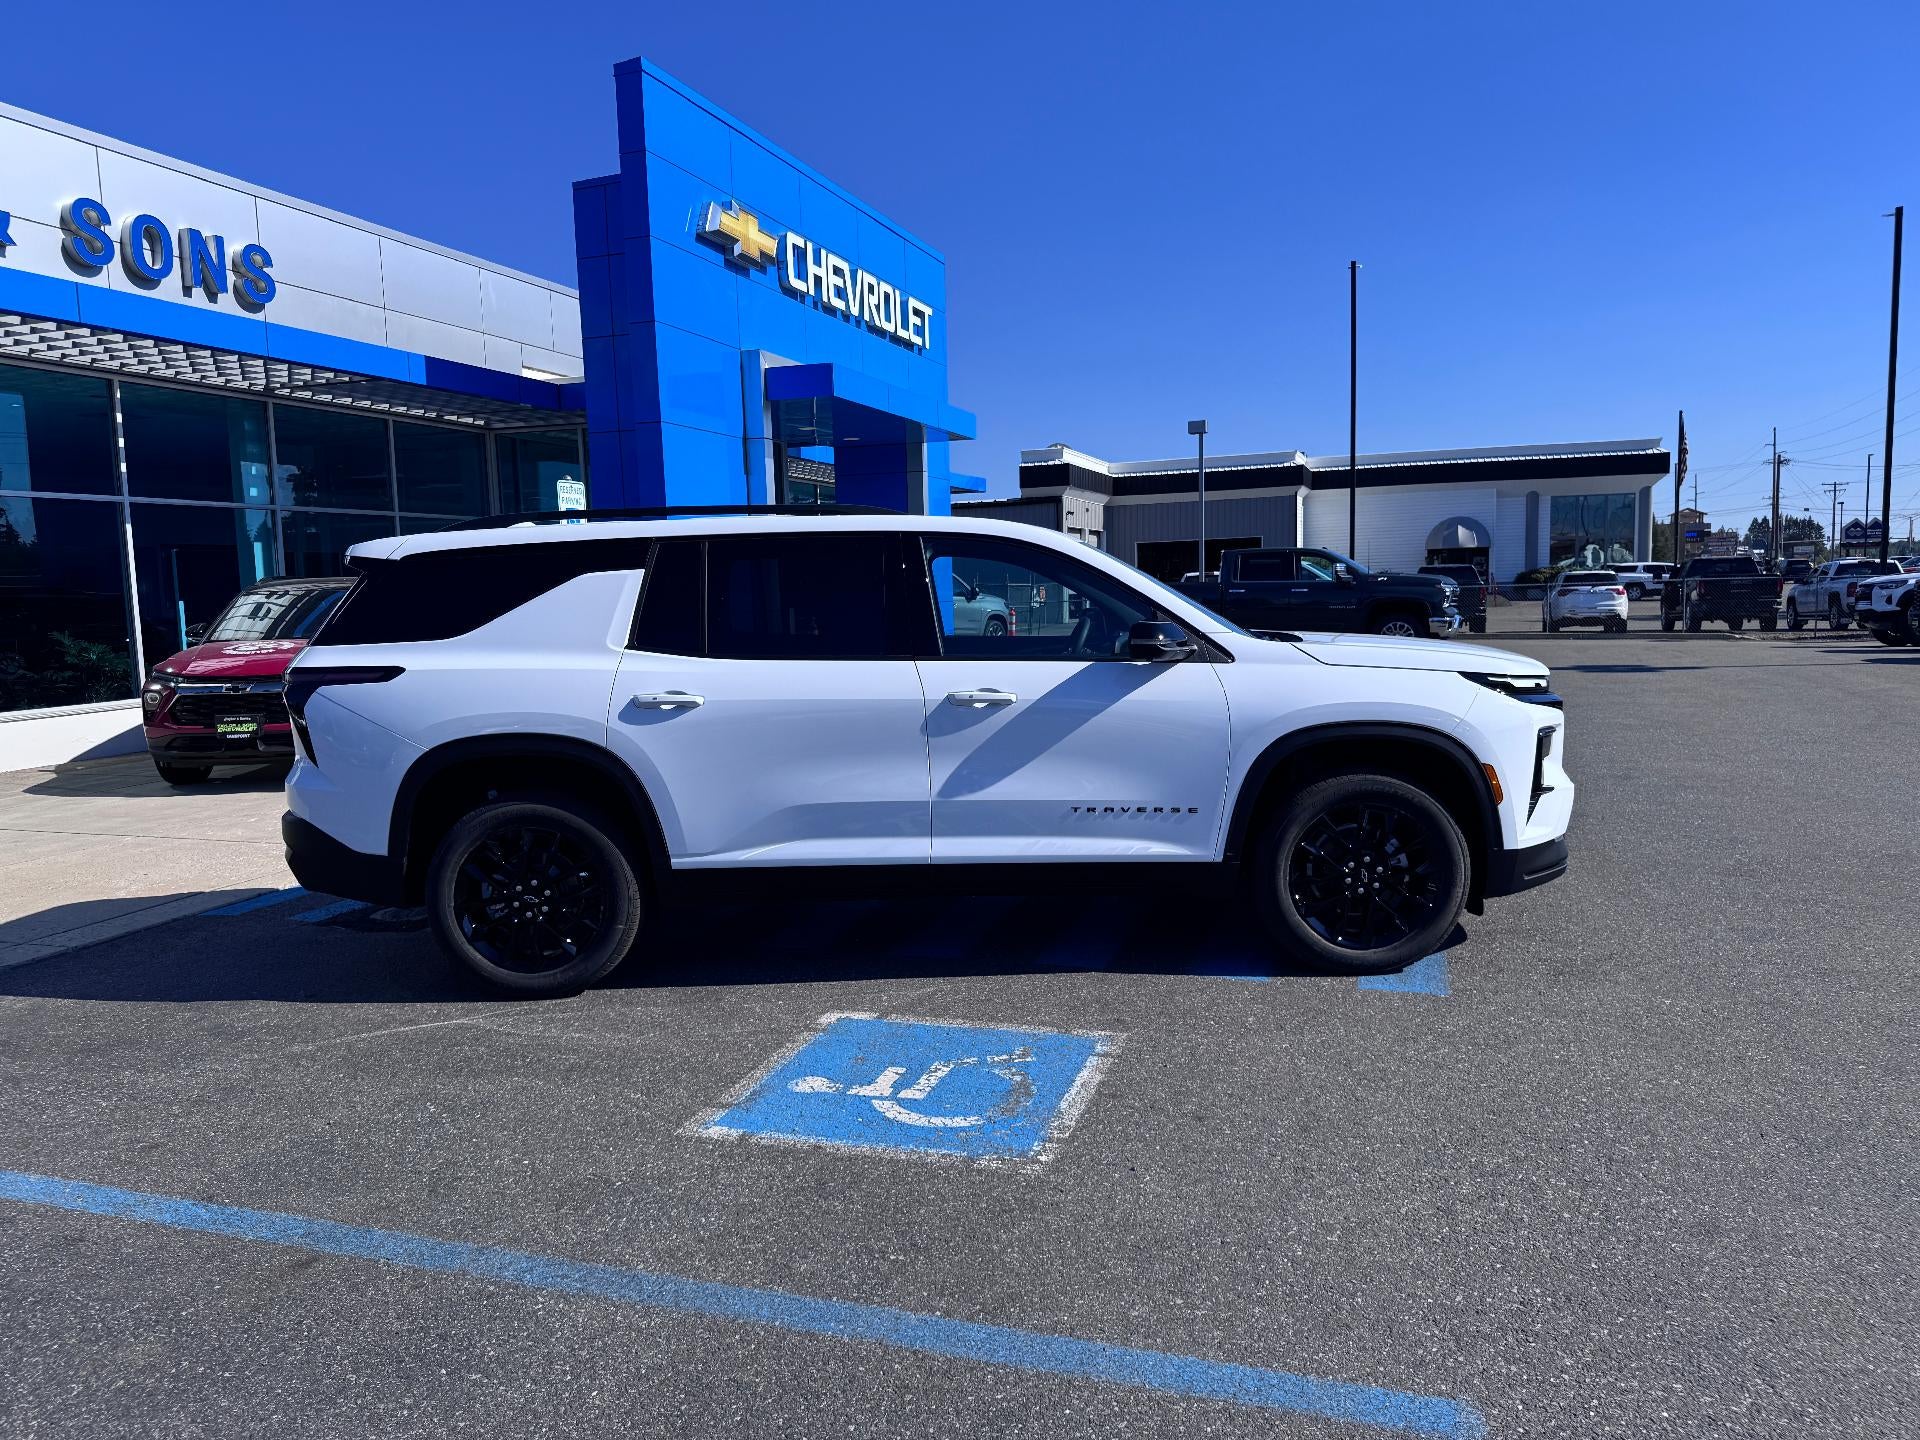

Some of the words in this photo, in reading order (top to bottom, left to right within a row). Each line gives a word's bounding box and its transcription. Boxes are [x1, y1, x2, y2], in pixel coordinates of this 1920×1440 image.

[61, 197, 276, 304] SONS
[783, 231, 933, 350] CHEVROLET
[1070, 806, 1199, 814] TRAVERSE
